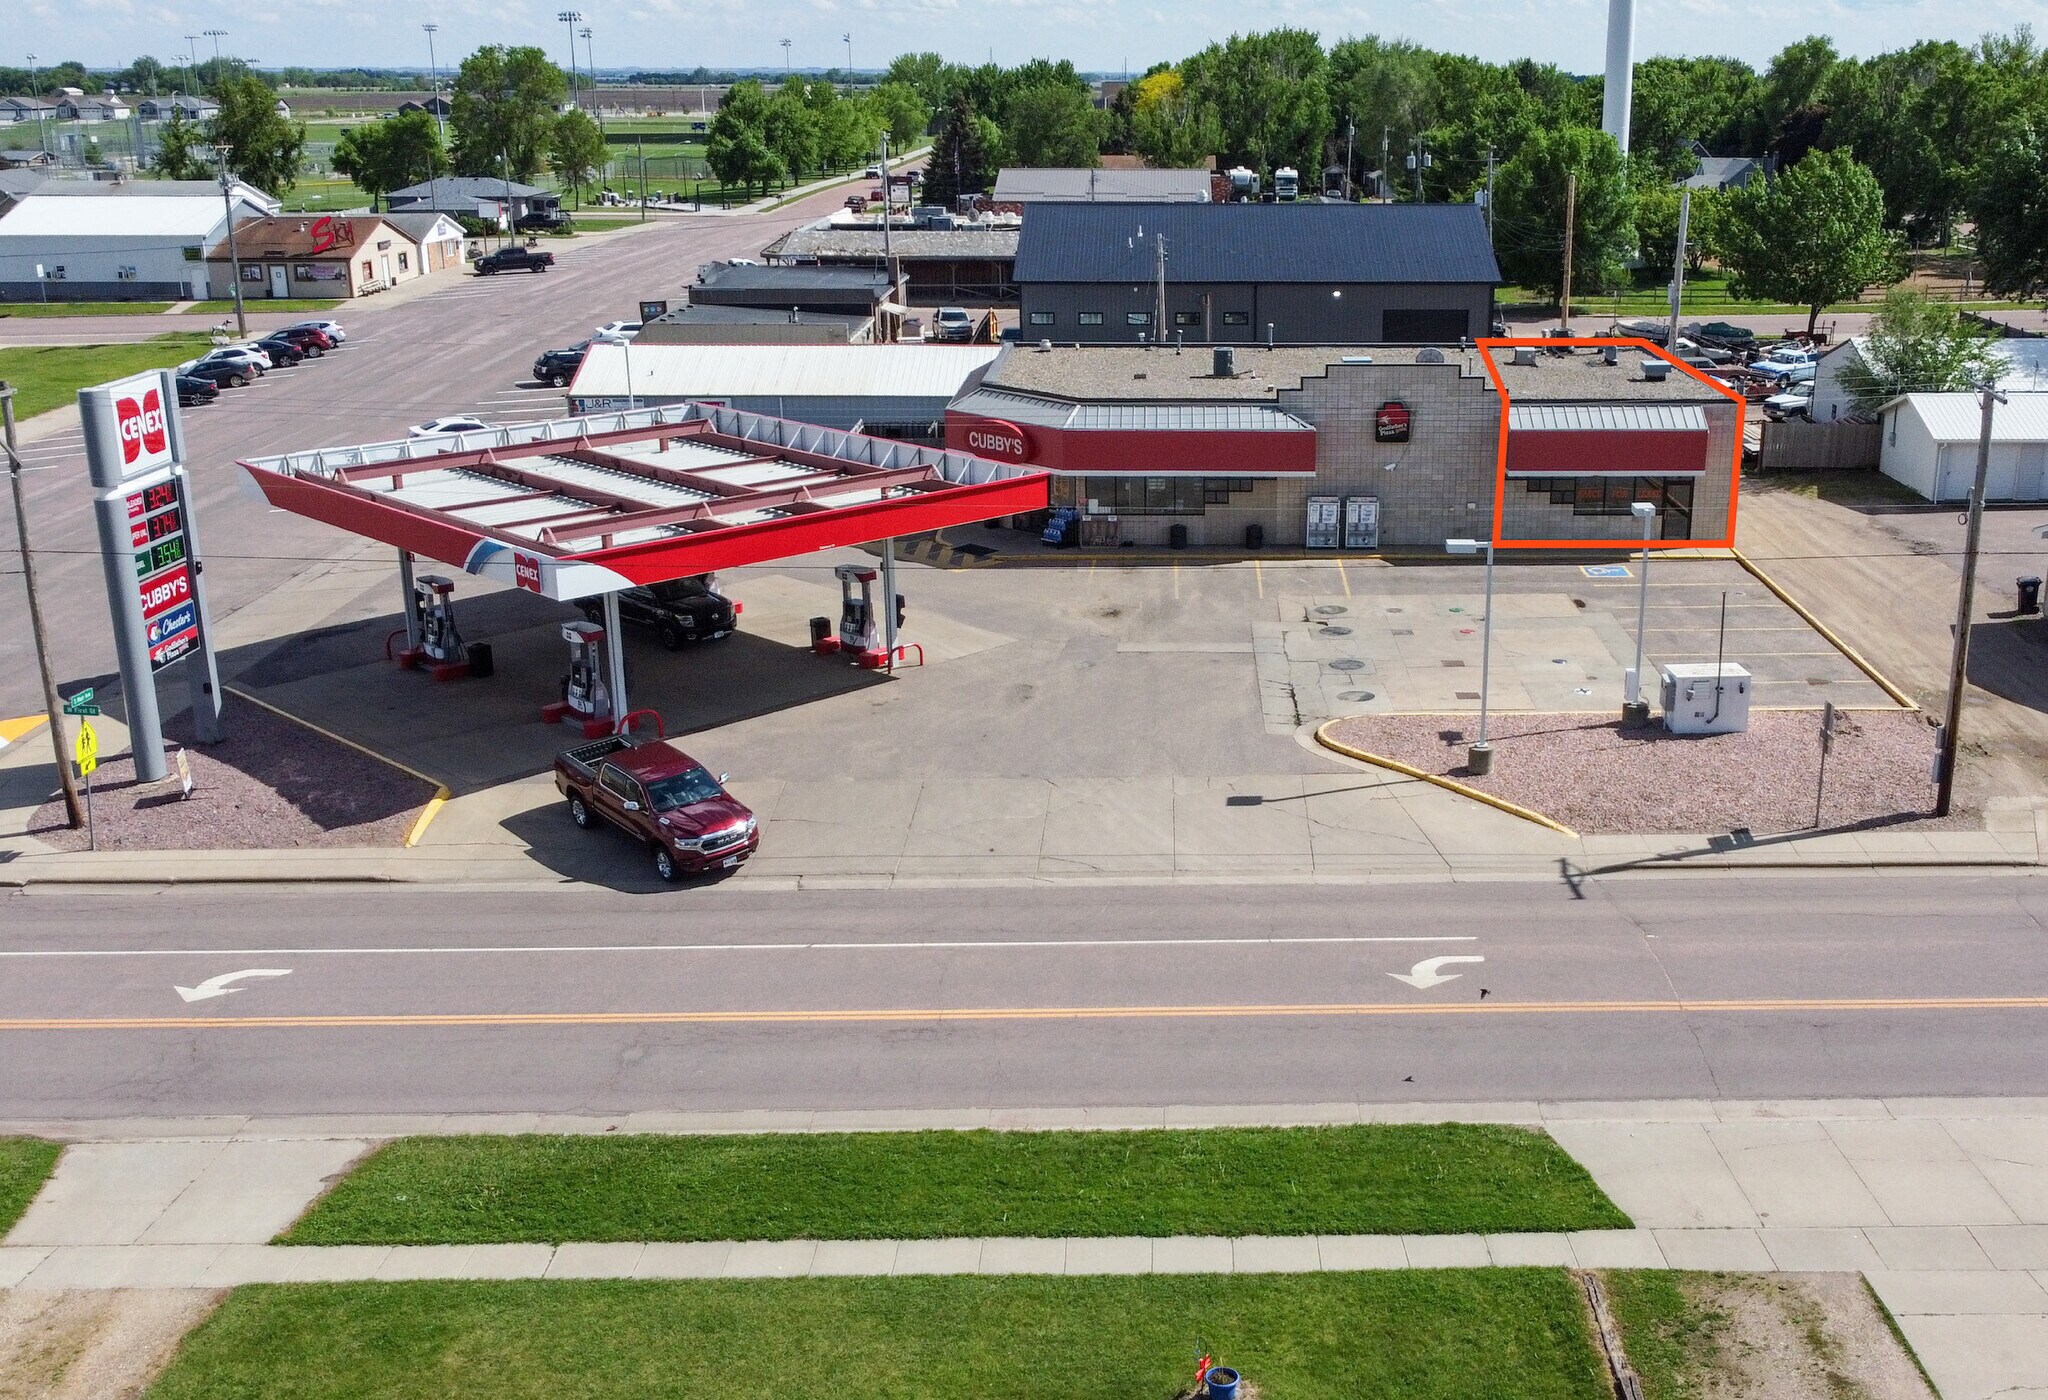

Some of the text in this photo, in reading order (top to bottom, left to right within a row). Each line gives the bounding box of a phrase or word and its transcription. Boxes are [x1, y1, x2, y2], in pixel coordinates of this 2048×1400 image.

[585, 398, 613, 408] J&R
[121, 408, 162, 441] CENEX
[969, 431, 1023, 454] CUBBY'S
[516, 564, 539, 582] CENEX
[140, 576, 187, 611] CUBBY'S
[162, 610, 191, 635] Chester's
